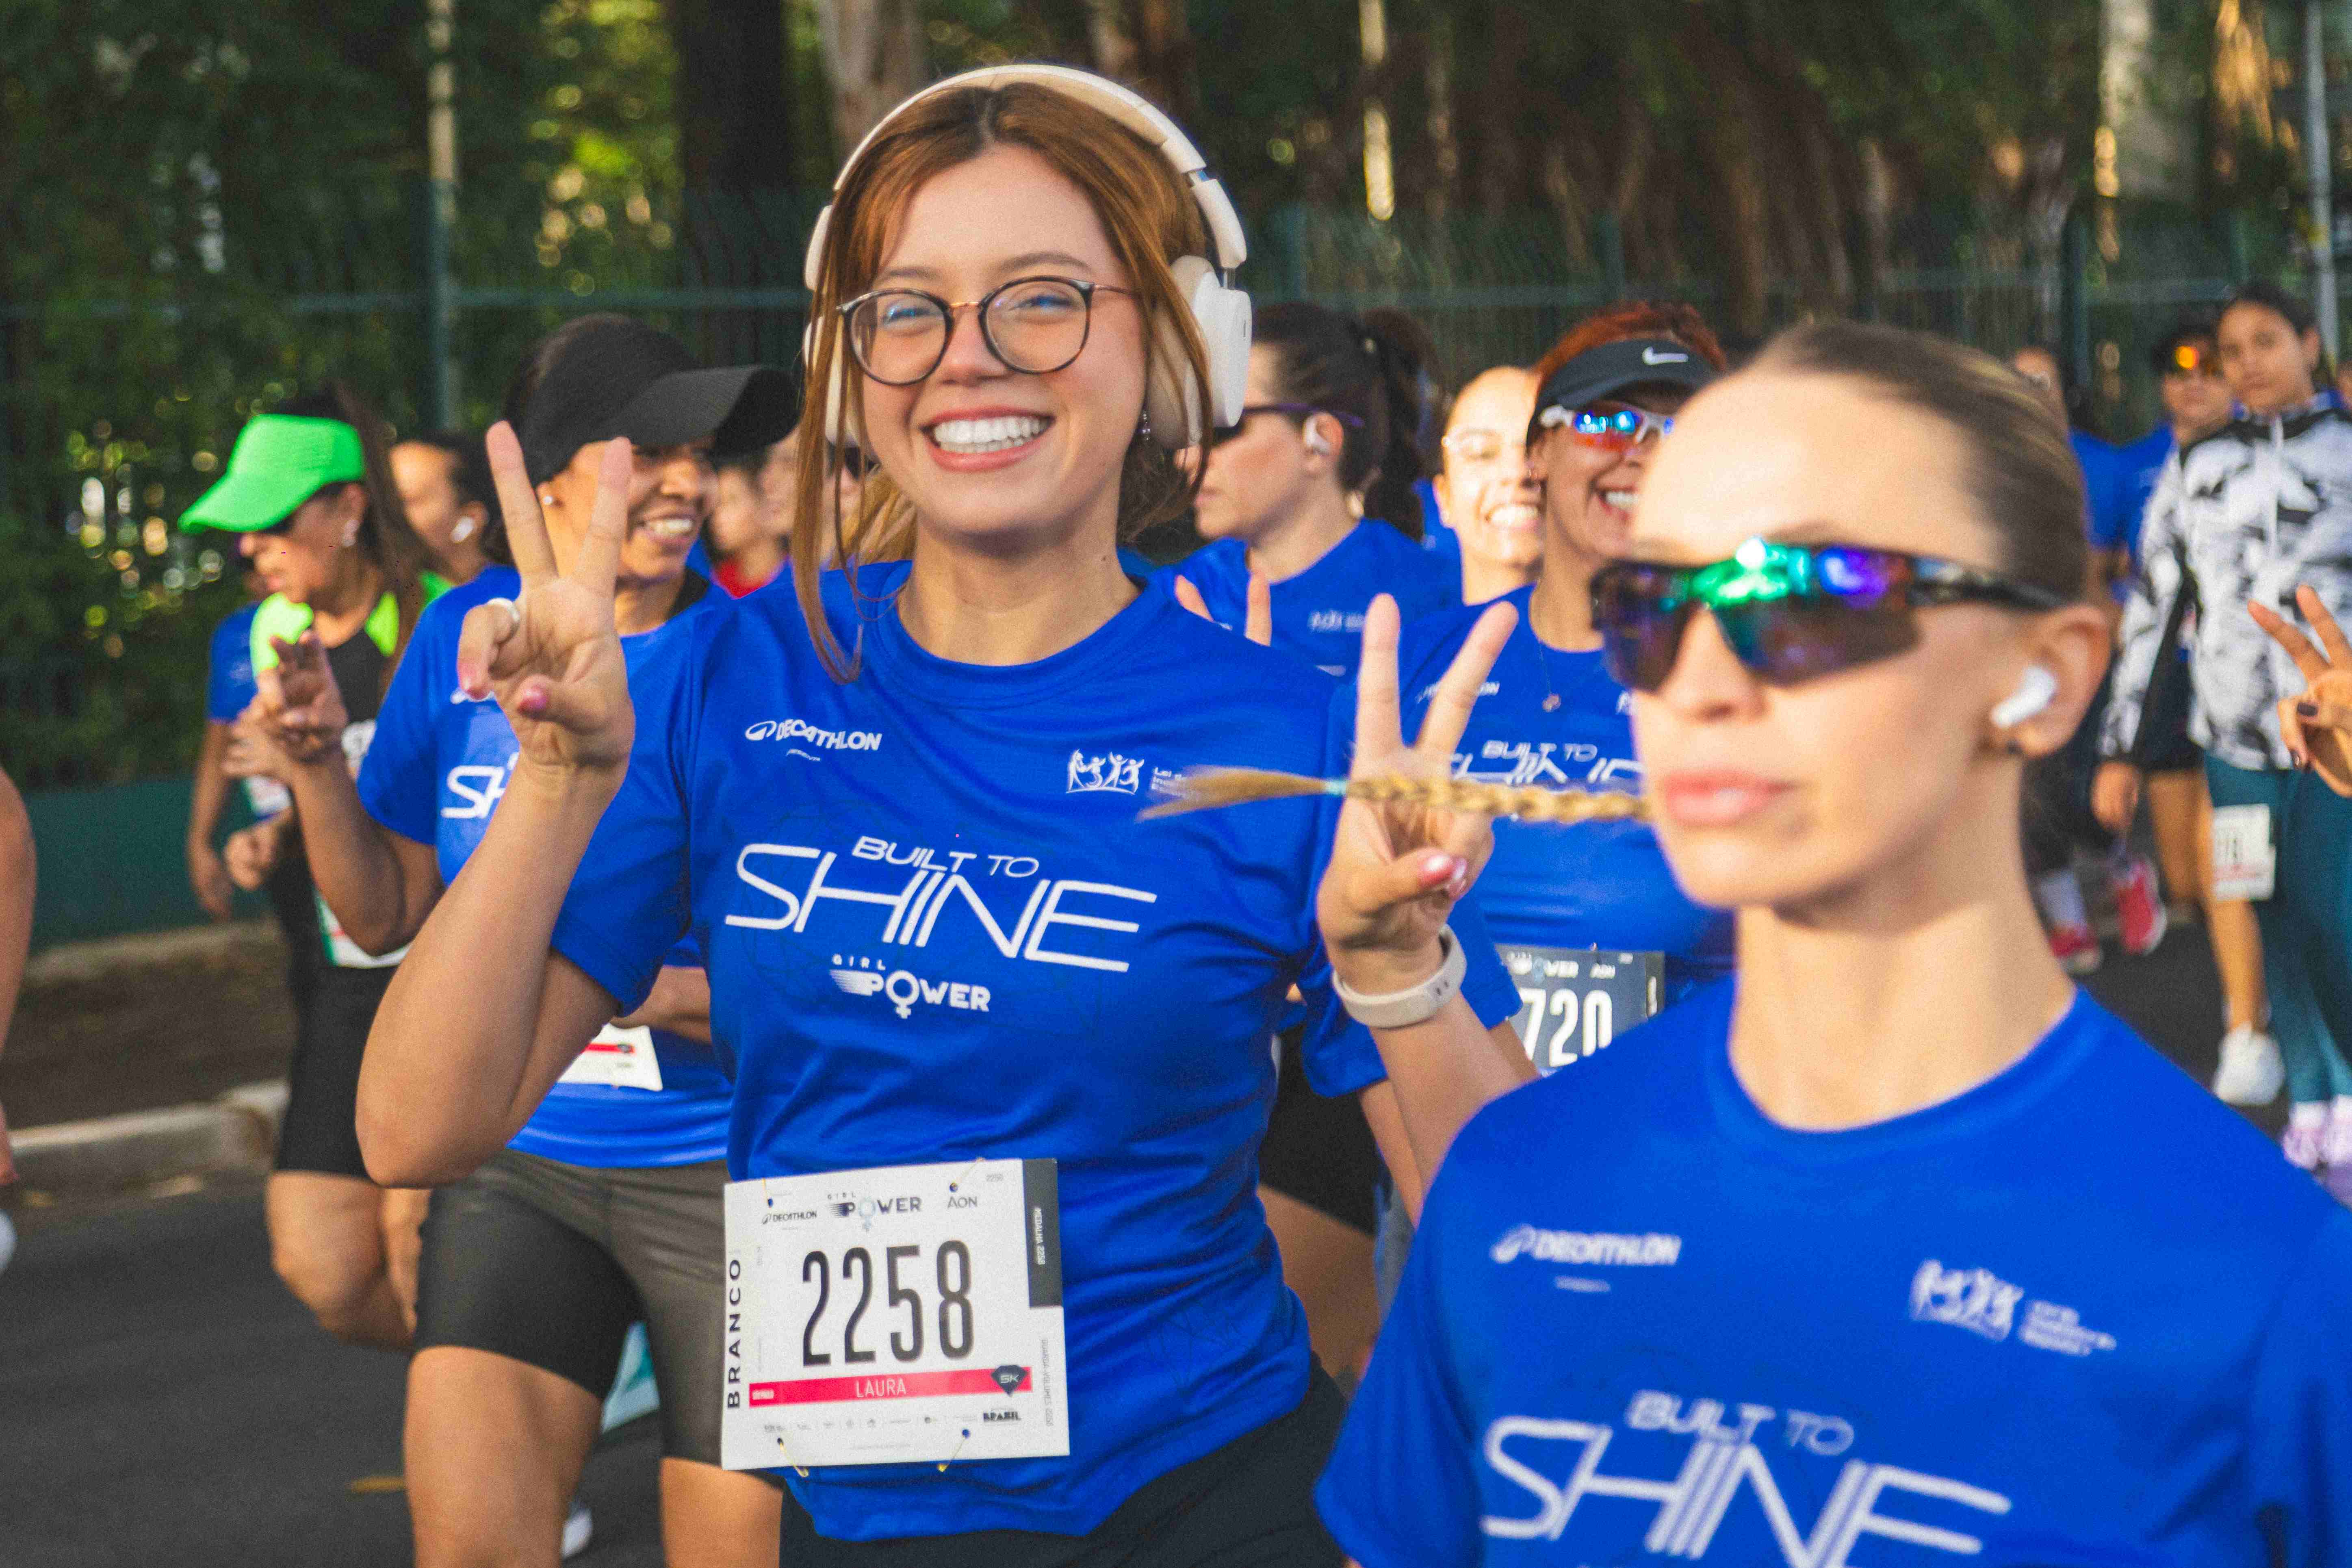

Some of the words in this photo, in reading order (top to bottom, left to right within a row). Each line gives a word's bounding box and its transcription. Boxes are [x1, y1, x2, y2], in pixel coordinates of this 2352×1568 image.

[776, 718, 882, 751] DECATHLON
[852, 836, 977, 872] BUILT
[987, 855, 1039, 878] TO
[725, 843, 1157, 972] SHINE
[832, 954, 886, 970] GIRL
[830, 969, 991, 1019] POWER
[773, 1211, 817, 1222] DECATHLON
[829, 1196, 923, 1225] POWER
[947, 1196, 978, 1209] AON
[802, 1240, 975, 1367] 2258
[727, 1260, 741, 1408] BRANCO
[856, 1378, 906, 1398] LAURA
[1625, 1390, 1775, 1442] BUILT
[1784, 1409, 1855, 1457] TO
